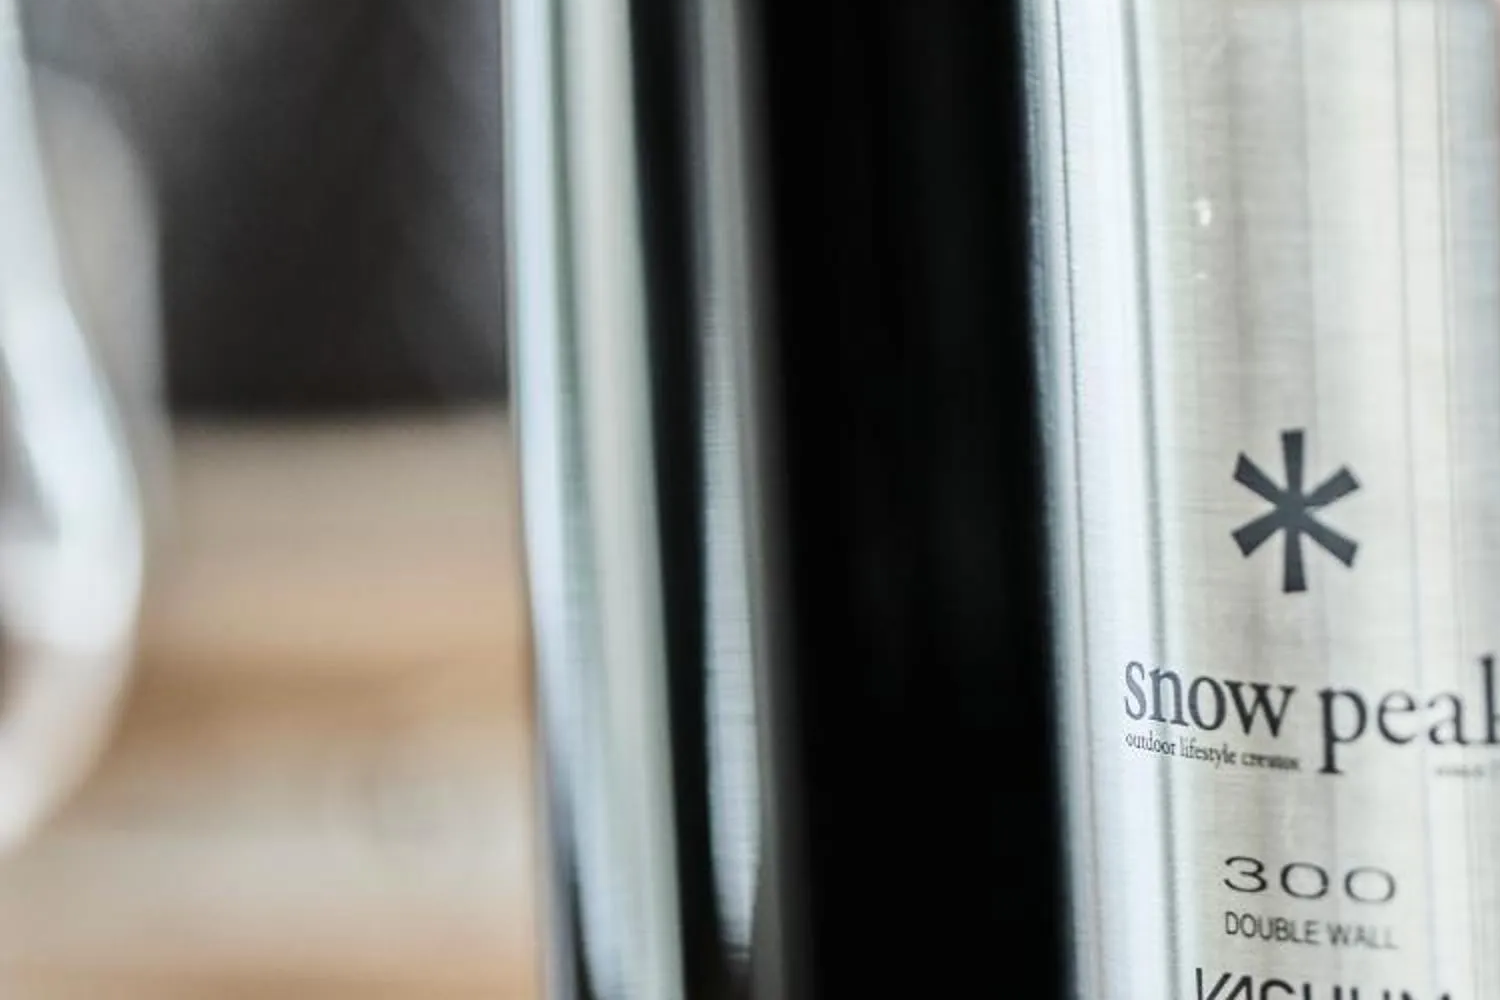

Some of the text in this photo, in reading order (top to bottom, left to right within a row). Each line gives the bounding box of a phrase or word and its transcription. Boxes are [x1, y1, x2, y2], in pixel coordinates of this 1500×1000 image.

[1125, 661, 1295, 737] snow
[1224, 856, 1396, 902] 300
[1224, 911, 1399, 949] DOUBLE WALL
